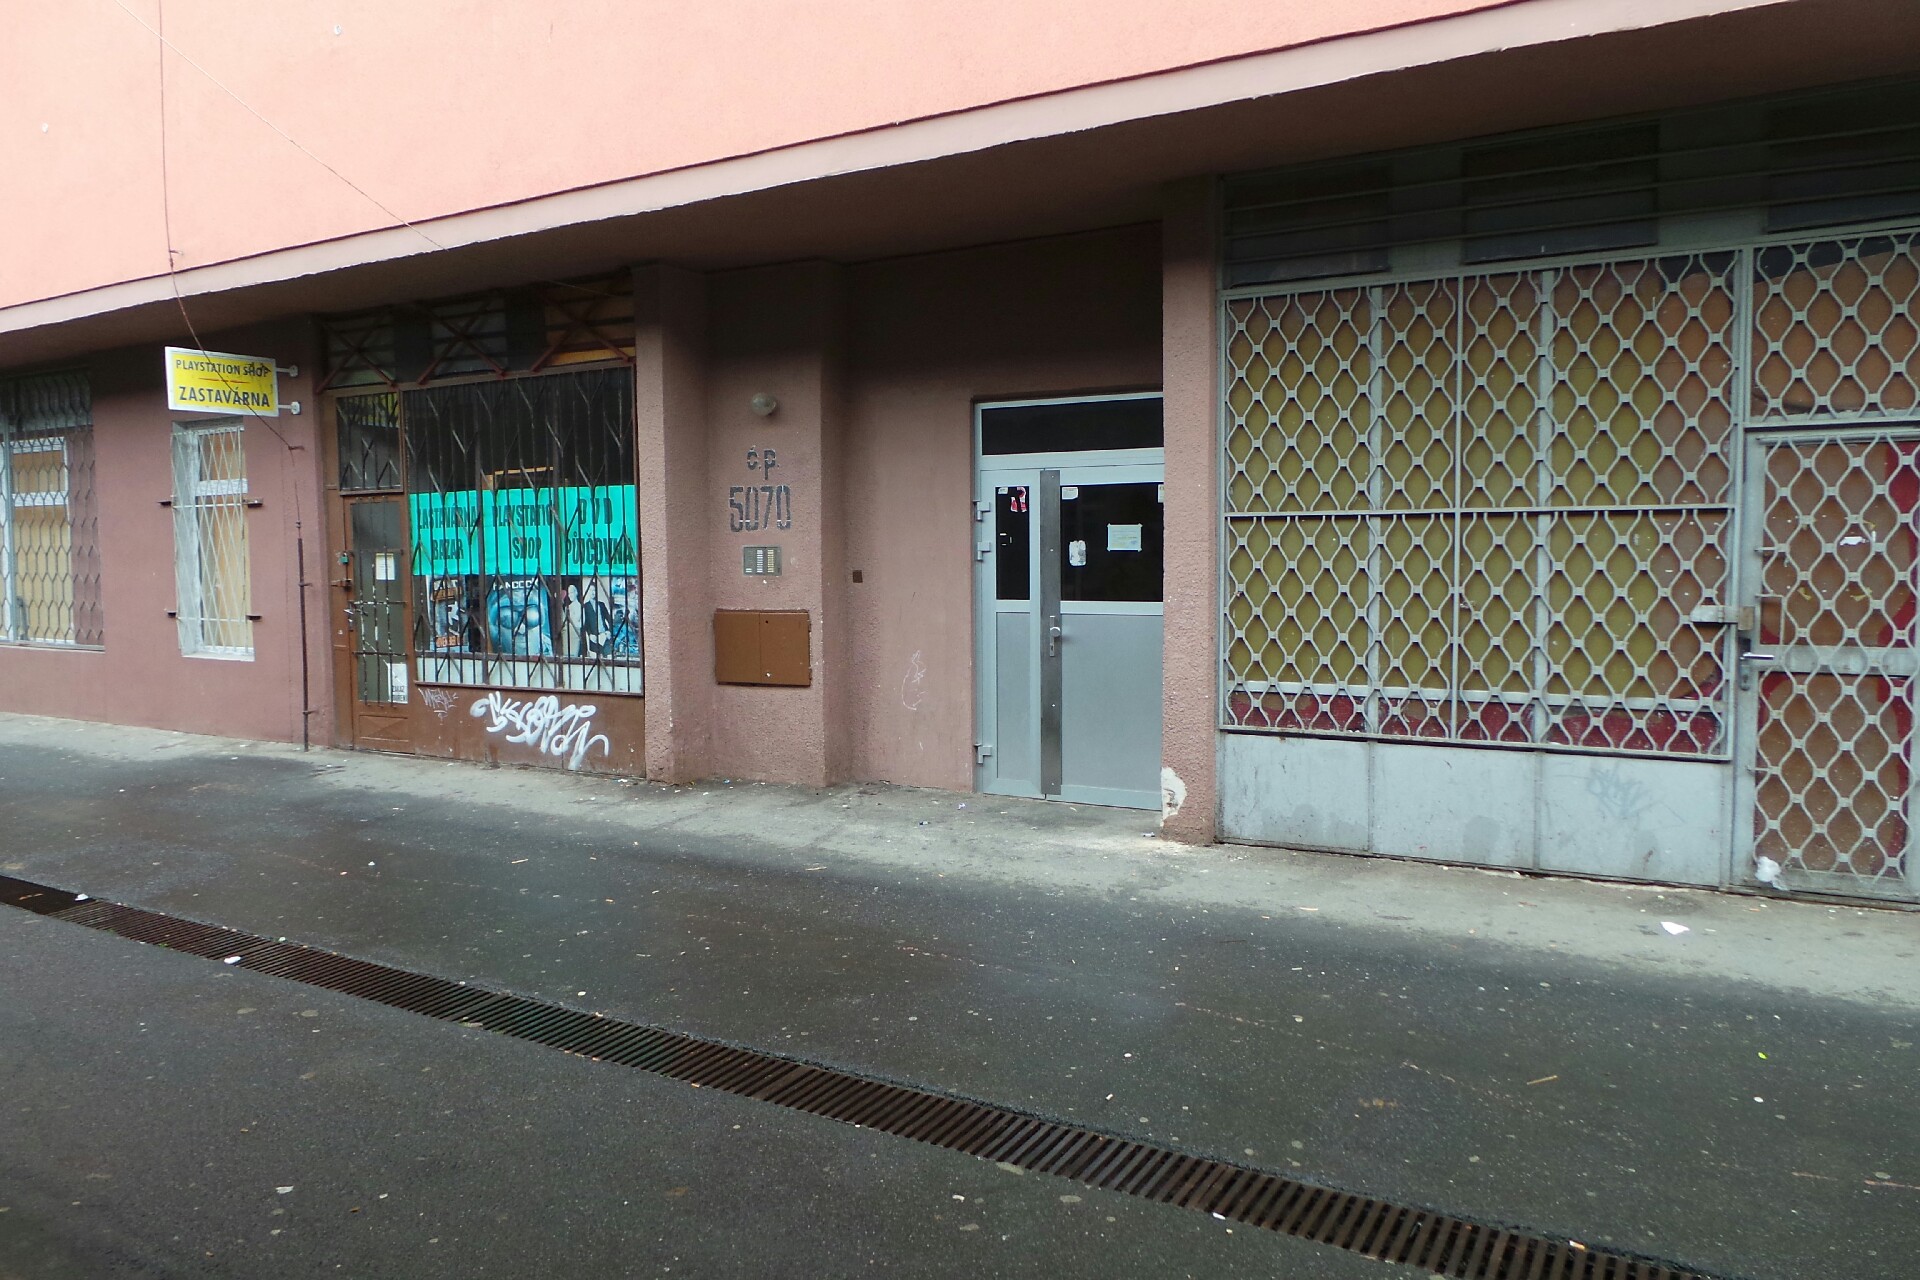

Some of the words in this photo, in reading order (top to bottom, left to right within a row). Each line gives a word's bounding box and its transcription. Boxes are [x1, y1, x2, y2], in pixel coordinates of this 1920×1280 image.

[175, 359, 241, 376] PLAYSTATION
[242, 363, 270, 378] SHOP
[178, 387, 271, 408] ZASTAVÁRNA
[491, 502, 555, 527] PLAYSTATIO
[729, 485, 790, 532] 5070
[431, 538, 464, 561] BAZAR
